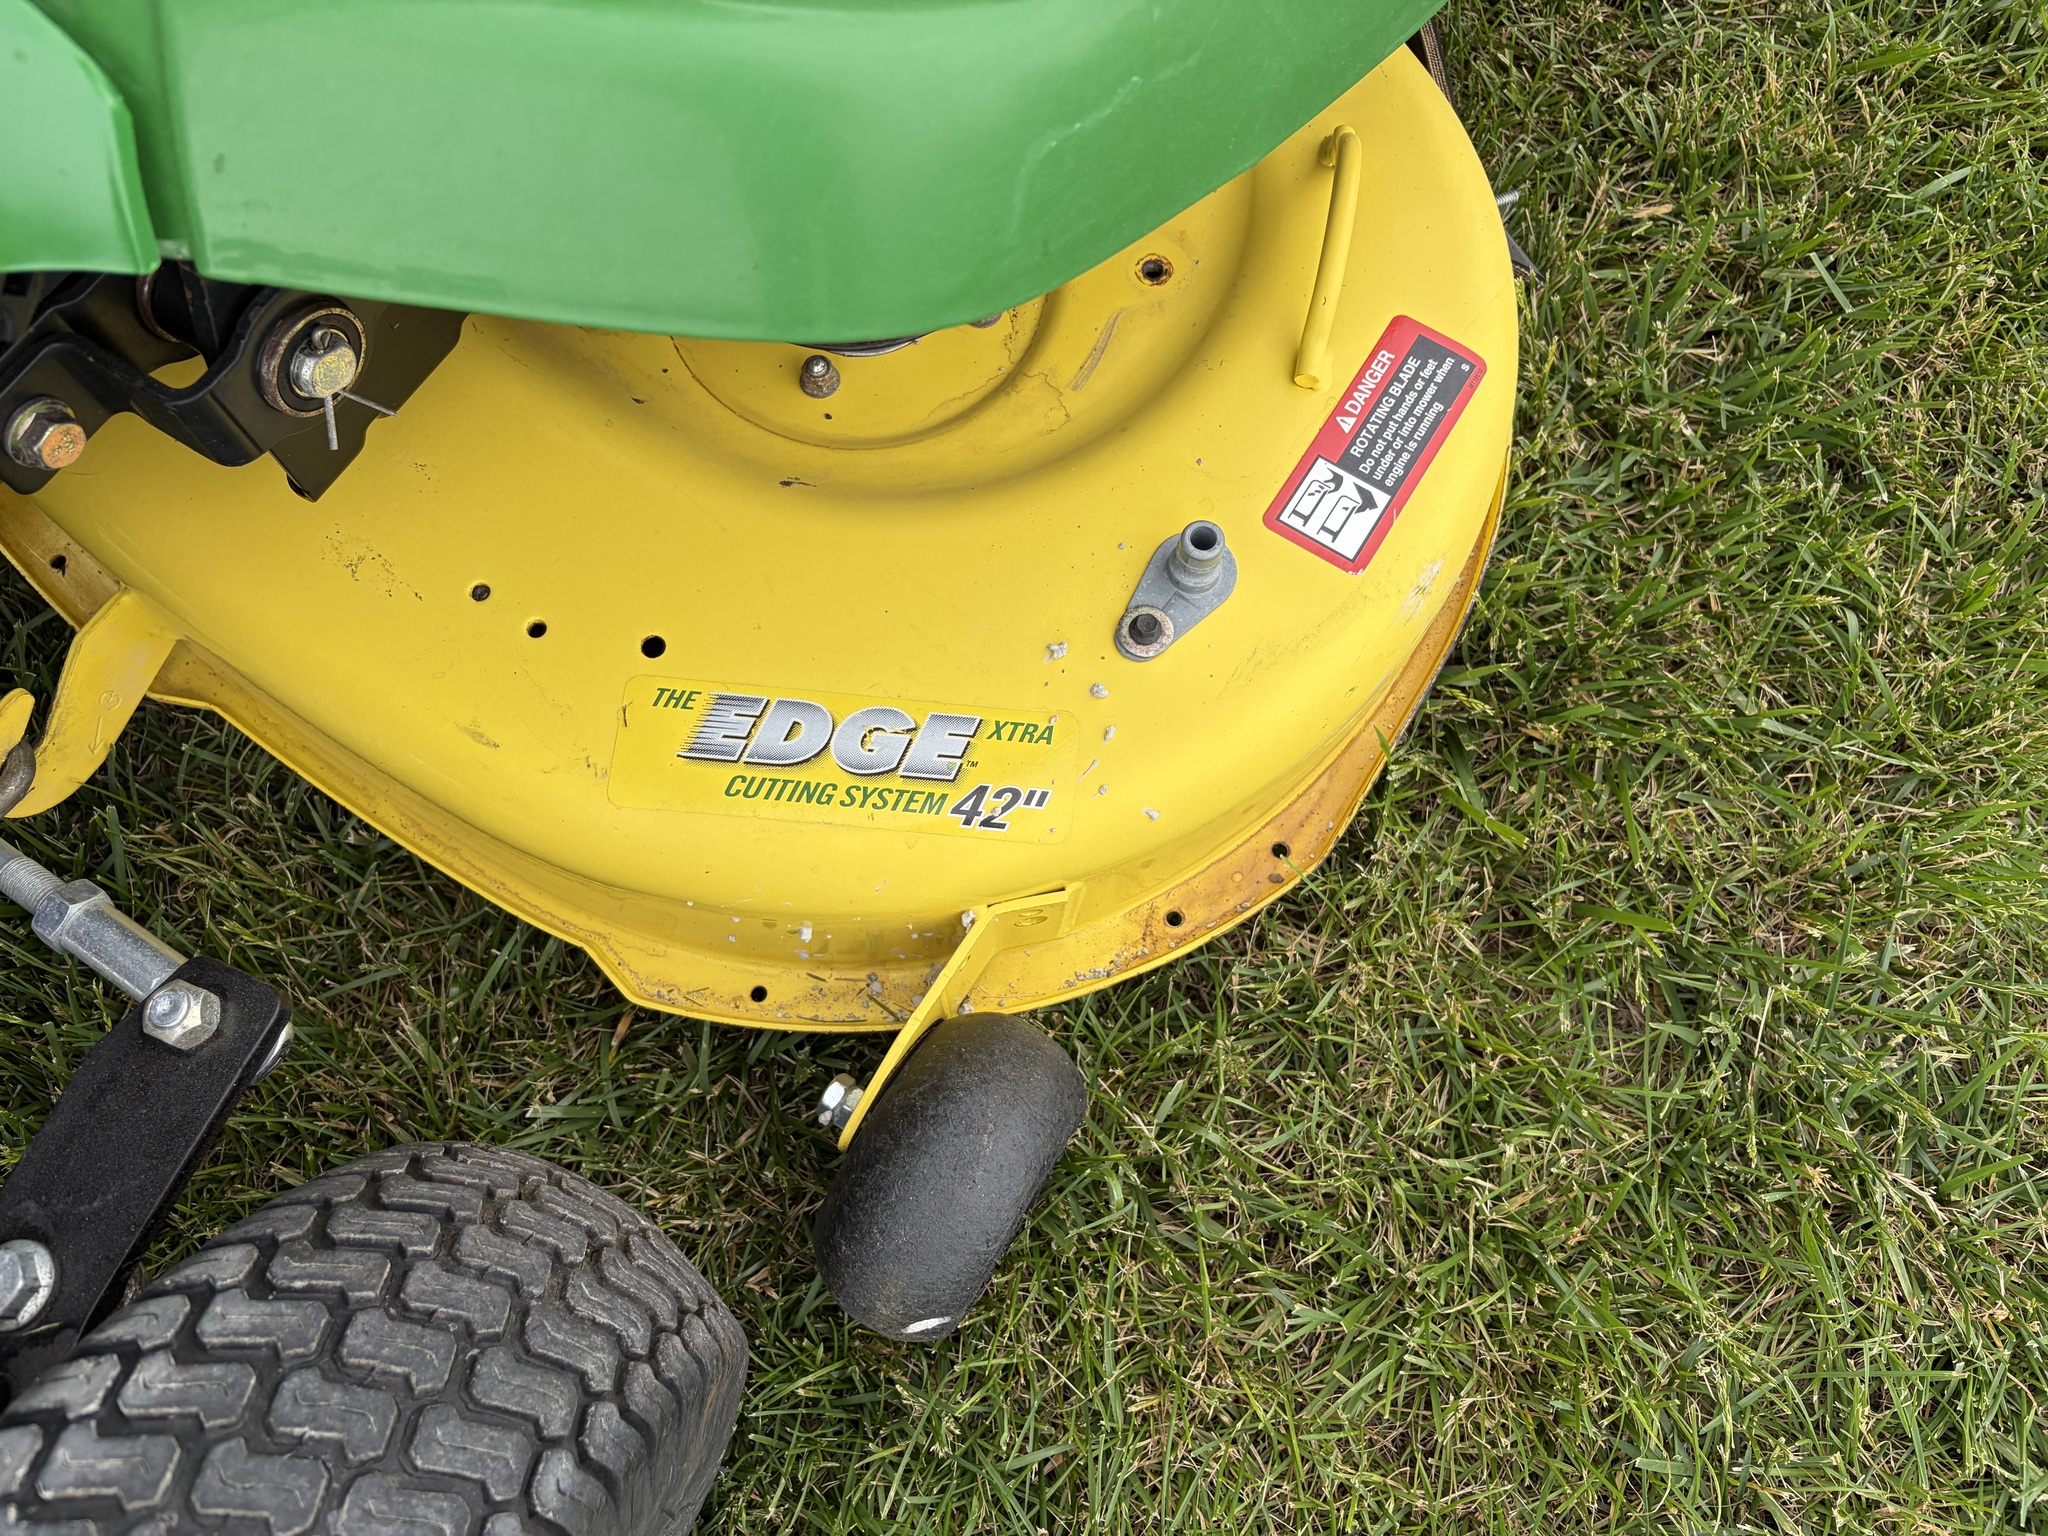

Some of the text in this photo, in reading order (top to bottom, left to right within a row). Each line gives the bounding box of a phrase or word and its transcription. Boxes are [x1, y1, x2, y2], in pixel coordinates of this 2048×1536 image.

[1344, 350, 1396, 415] DANGER
[1350, 356, 1421, 458] ROTATING BLADE
[1358, 358, 1439, 474] Do not put hands or feet
[1372, 357, 1456, 480] under or into mower when
[1384, 401, 1444, 487] engine is running
[652, 688, 702, 710] THE
[676, 691, 983, 783] EDGE
[986, 720, 1054, 745] XTRA
[724, 775, 1052, 831] CUTTING SYSTEM 42"
